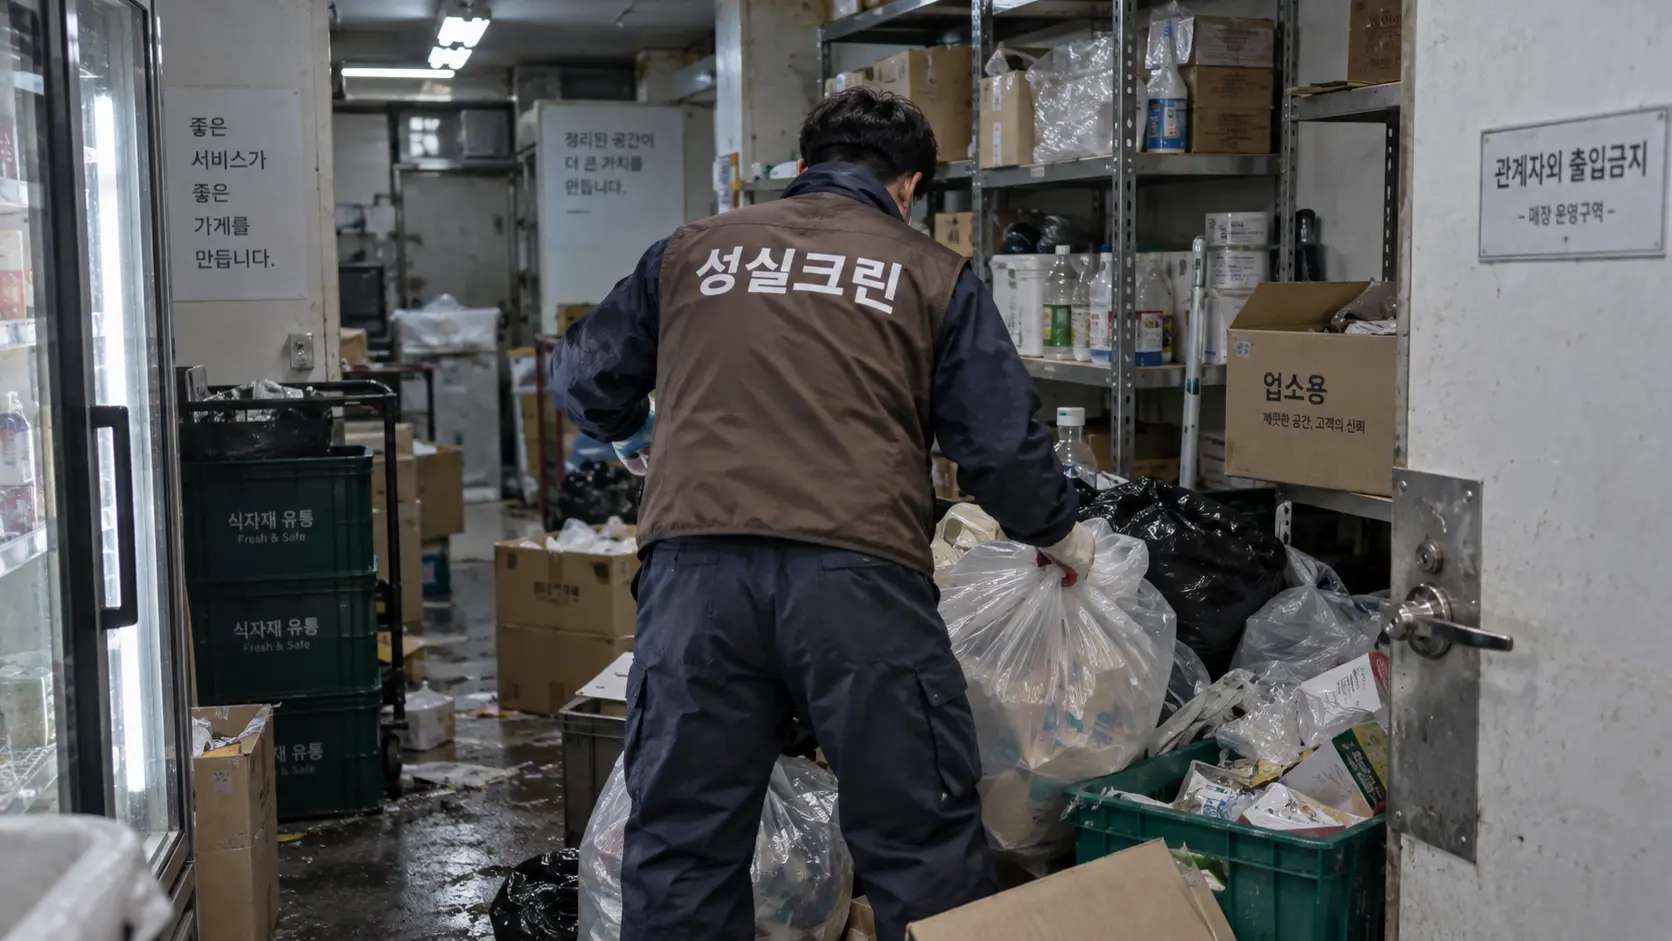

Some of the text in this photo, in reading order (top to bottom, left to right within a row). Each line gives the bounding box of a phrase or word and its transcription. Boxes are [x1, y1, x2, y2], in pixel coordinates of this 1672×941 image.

[189, 117, 228, 138] 좋은
[564, 131, 655, 150] 정리된 공간이
[191, 149, 267, 171] 서비스가
[564, 155, 644, 173] 더 큰 가치를
[1494, 140, 1648, 189] 관계자외 출입금지
[191, 183, 230, 204] 좋은
[565, 178, 627, 196] 만듭니다.
[194, 215, 250, 237] 가게를
[195, 248, 275, 270] 만듭니다.
[695, 245, 903, 315] 성실크린
[1263, 371, 1328, 406] 업소용
[1292, 413, 1313, 431] 공간,
[1315, 416, 1344, 433] 고객의
[228, 509, 314, 531] 식자재 유통
[237, 531, 306, 545] Fresh & Safe
[233, 616, 320, 640] 식자재 유통
[242, 641, 273, 653] Fresh
[287, 639, 311, 650] Safe
[291, 742, 324, 762] 유통
